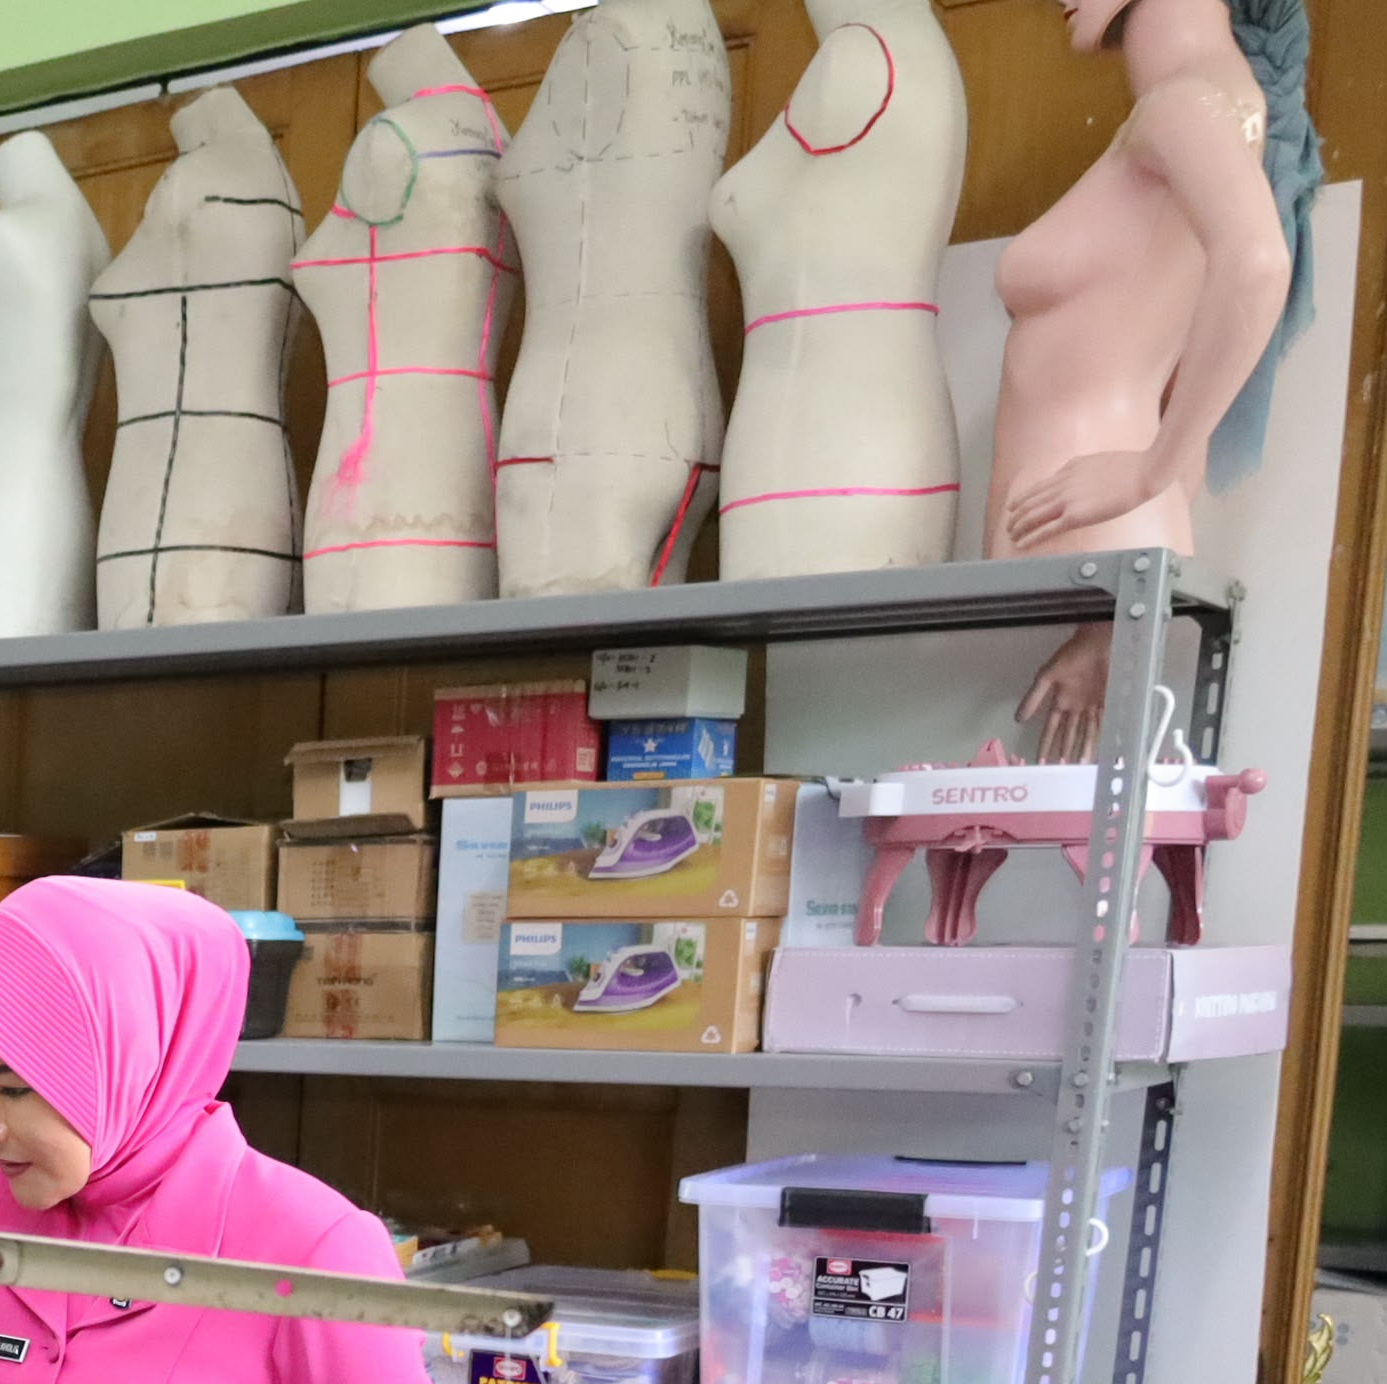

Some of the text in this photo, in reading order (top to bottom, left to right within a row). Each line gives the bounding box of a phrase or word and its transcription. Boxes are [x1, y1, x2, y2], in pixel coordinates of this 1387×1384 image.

[932, 785, 1028, 805] SENTRO
[530, 801, 573, 811] PHILIPS
[515, 934, 557, 944] PHILIPS
[816, 1275, 859, 1286] ACCURATE
[868, 1305, 886, 1318] CB
[887, 1307, 904, 1320] 47
